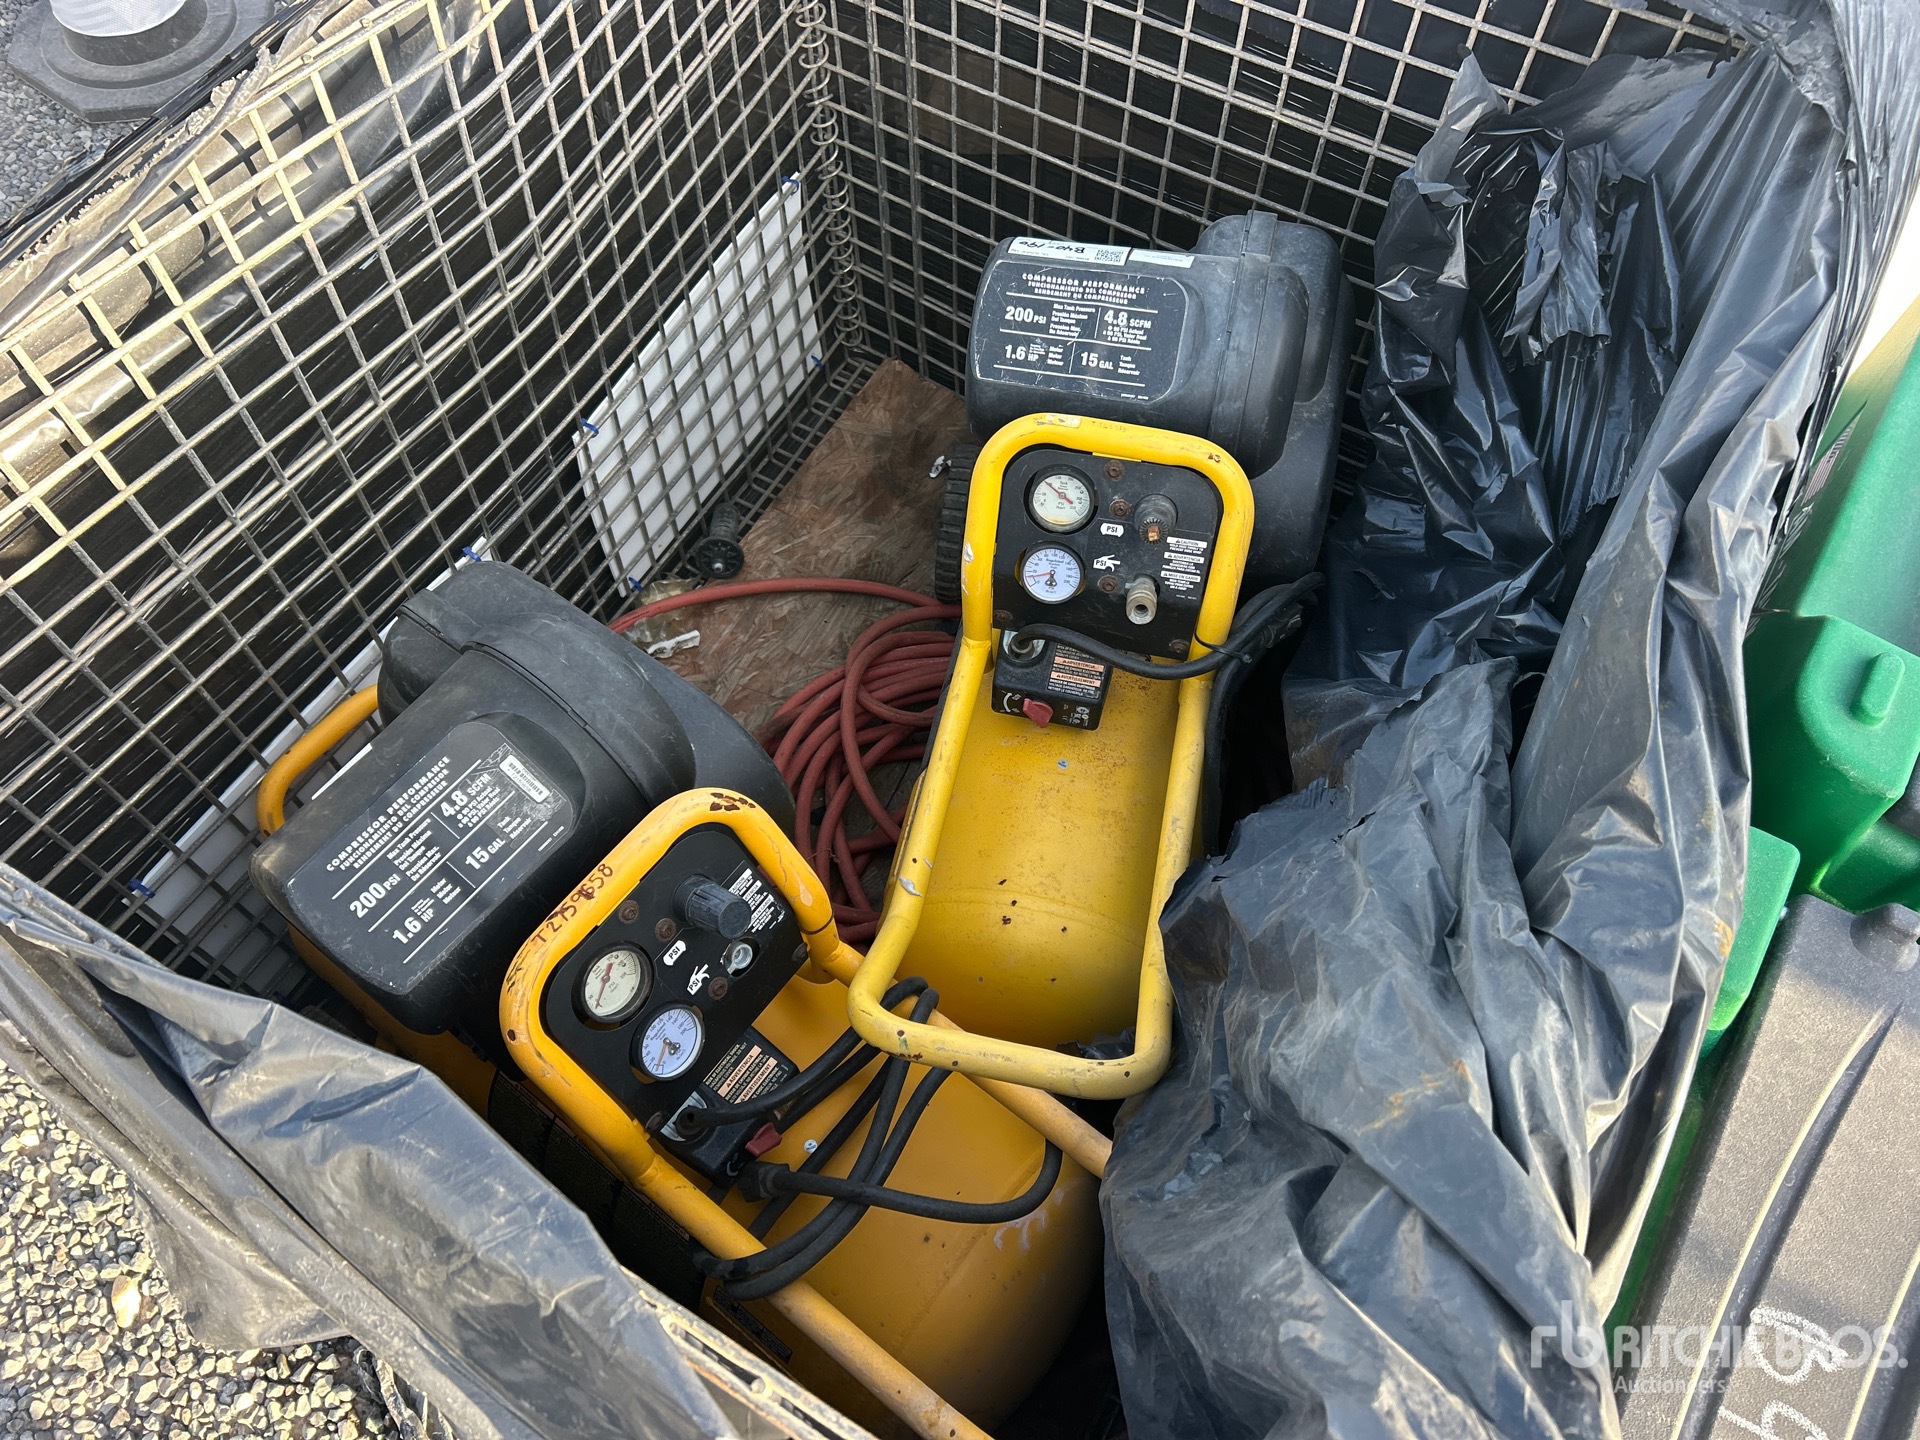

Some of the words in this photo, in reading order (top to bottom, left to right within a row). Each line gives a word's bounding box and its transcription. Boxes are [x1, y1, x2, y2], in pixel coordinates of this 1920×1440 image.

[1022, 273, 1078, 286] COMPRESSOR
[1082, 280, 1145, 294] PERFORMANCE
[1027, 280, 1084, 292] FUNCIONAMIENTO
[1098, 288, 1136, 299] COMPRESOR
[1034, 288, 1071, 297] RENDEMENT
[1083, 293, 1128, 304] COMPRESSEUR
[1004, 305, 1034, 323] 200
[1032, 314, 1046, 324] PSI
[1103, 309, 1128, 326] 4.8
[1128, 318, 1151, 329] SCFM
[1003, 344, 1026, 360] 1.6
[1027, 353, 1038, 361] HP
[1080, 350, 1098, 367] 15
[1098, 359, 1114, 370] GAL
[1060, 675, 1095, 684] AVERTISSEMENT
[439, 788, 467, 818] 4.8
[466, 772, 491, 797] SCFM
[326, 813, 386, 872] COMPRESSOR
[387, 754, 450, 816] PERFORMANCE
[340, 814, 398, 871] FUNCIONAMIENTO
[397, 802, 410, 816] DEL
[410, 767, 449, 805] COMPRESOR
[497, 814, 510, 828] Tank
[353, 830, 393, 869] RENDEMENT
[392, 820, 403, 832] DU
[402, 779, 447, 823] COMPRESSEUR
[503, 816, 521, 834] Tanque
[397, 836, 410, 850] Tank
[465, 846, 489, 871] 15
[487, 835, 505, 854] GAL
[349, 881, 385, 918] 200
[383, 873, 400, 891] PSI
[391, 915, 421, 946] 1.6
[421, 907, 435, 922] HP
[668, 946, 681, 960] PSI
[688, 976, 700, 991] PSI
[728, 1054, 755, 1082] ADVERTENCIA
[741, 1063, 773, 1098] AVERTISSEMENT
